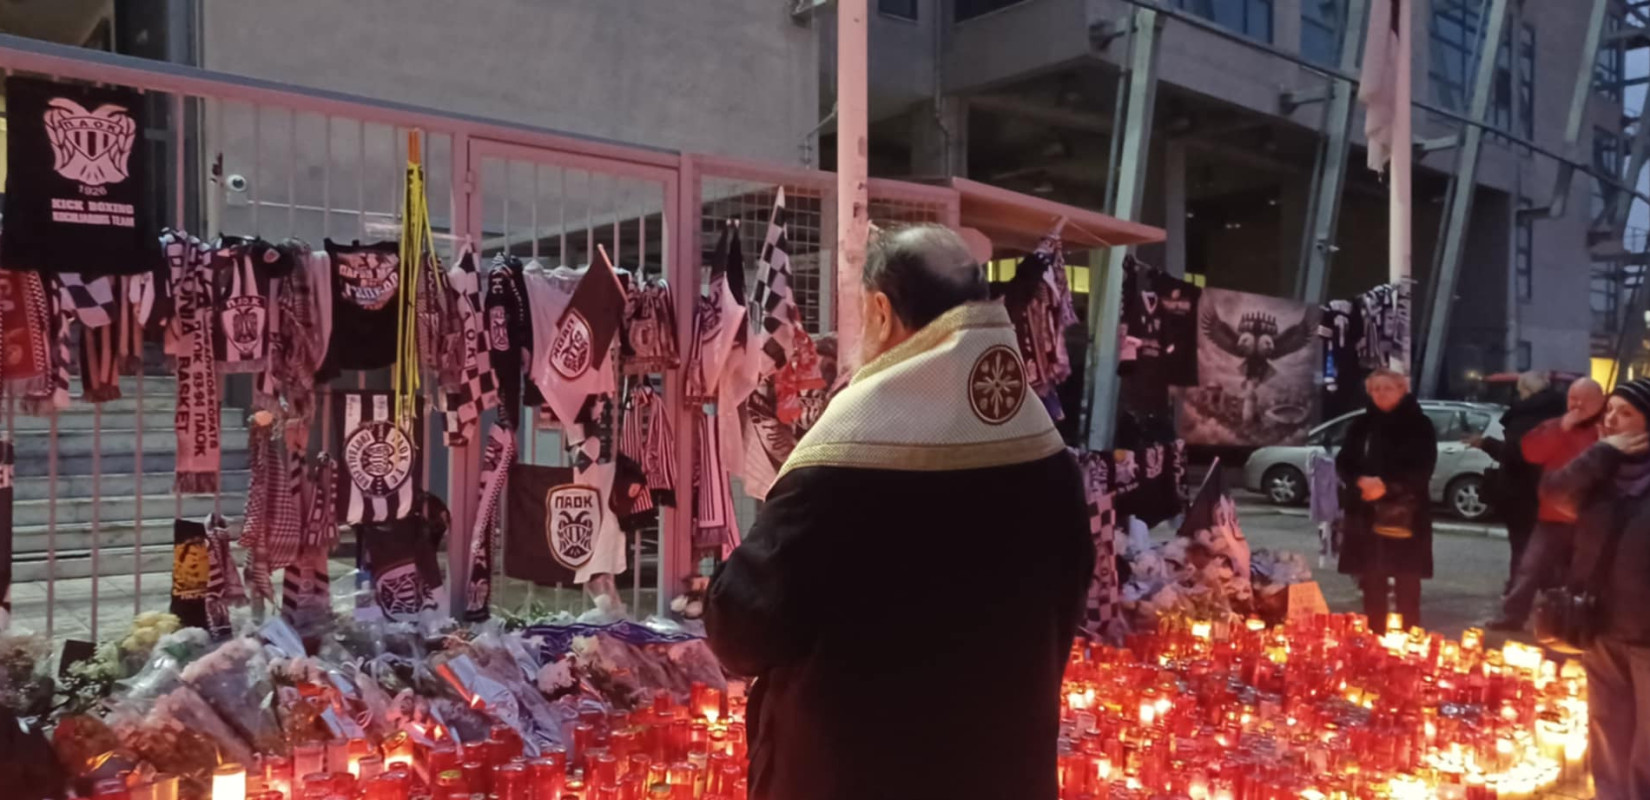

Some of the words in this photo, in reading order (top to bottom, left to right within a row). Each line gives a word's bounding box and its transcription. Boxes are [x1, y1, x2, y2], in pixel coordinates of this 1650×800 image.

[51, 198, 84, 210] KICK
[88, 201, 134, 214] BOXING
[554, 319, 575, 359] ΠΑΟΚ
[194, 413, 207, 457] ΠΑΟΚ
[555, 495, 593, 508] ΠΑΟΚ
